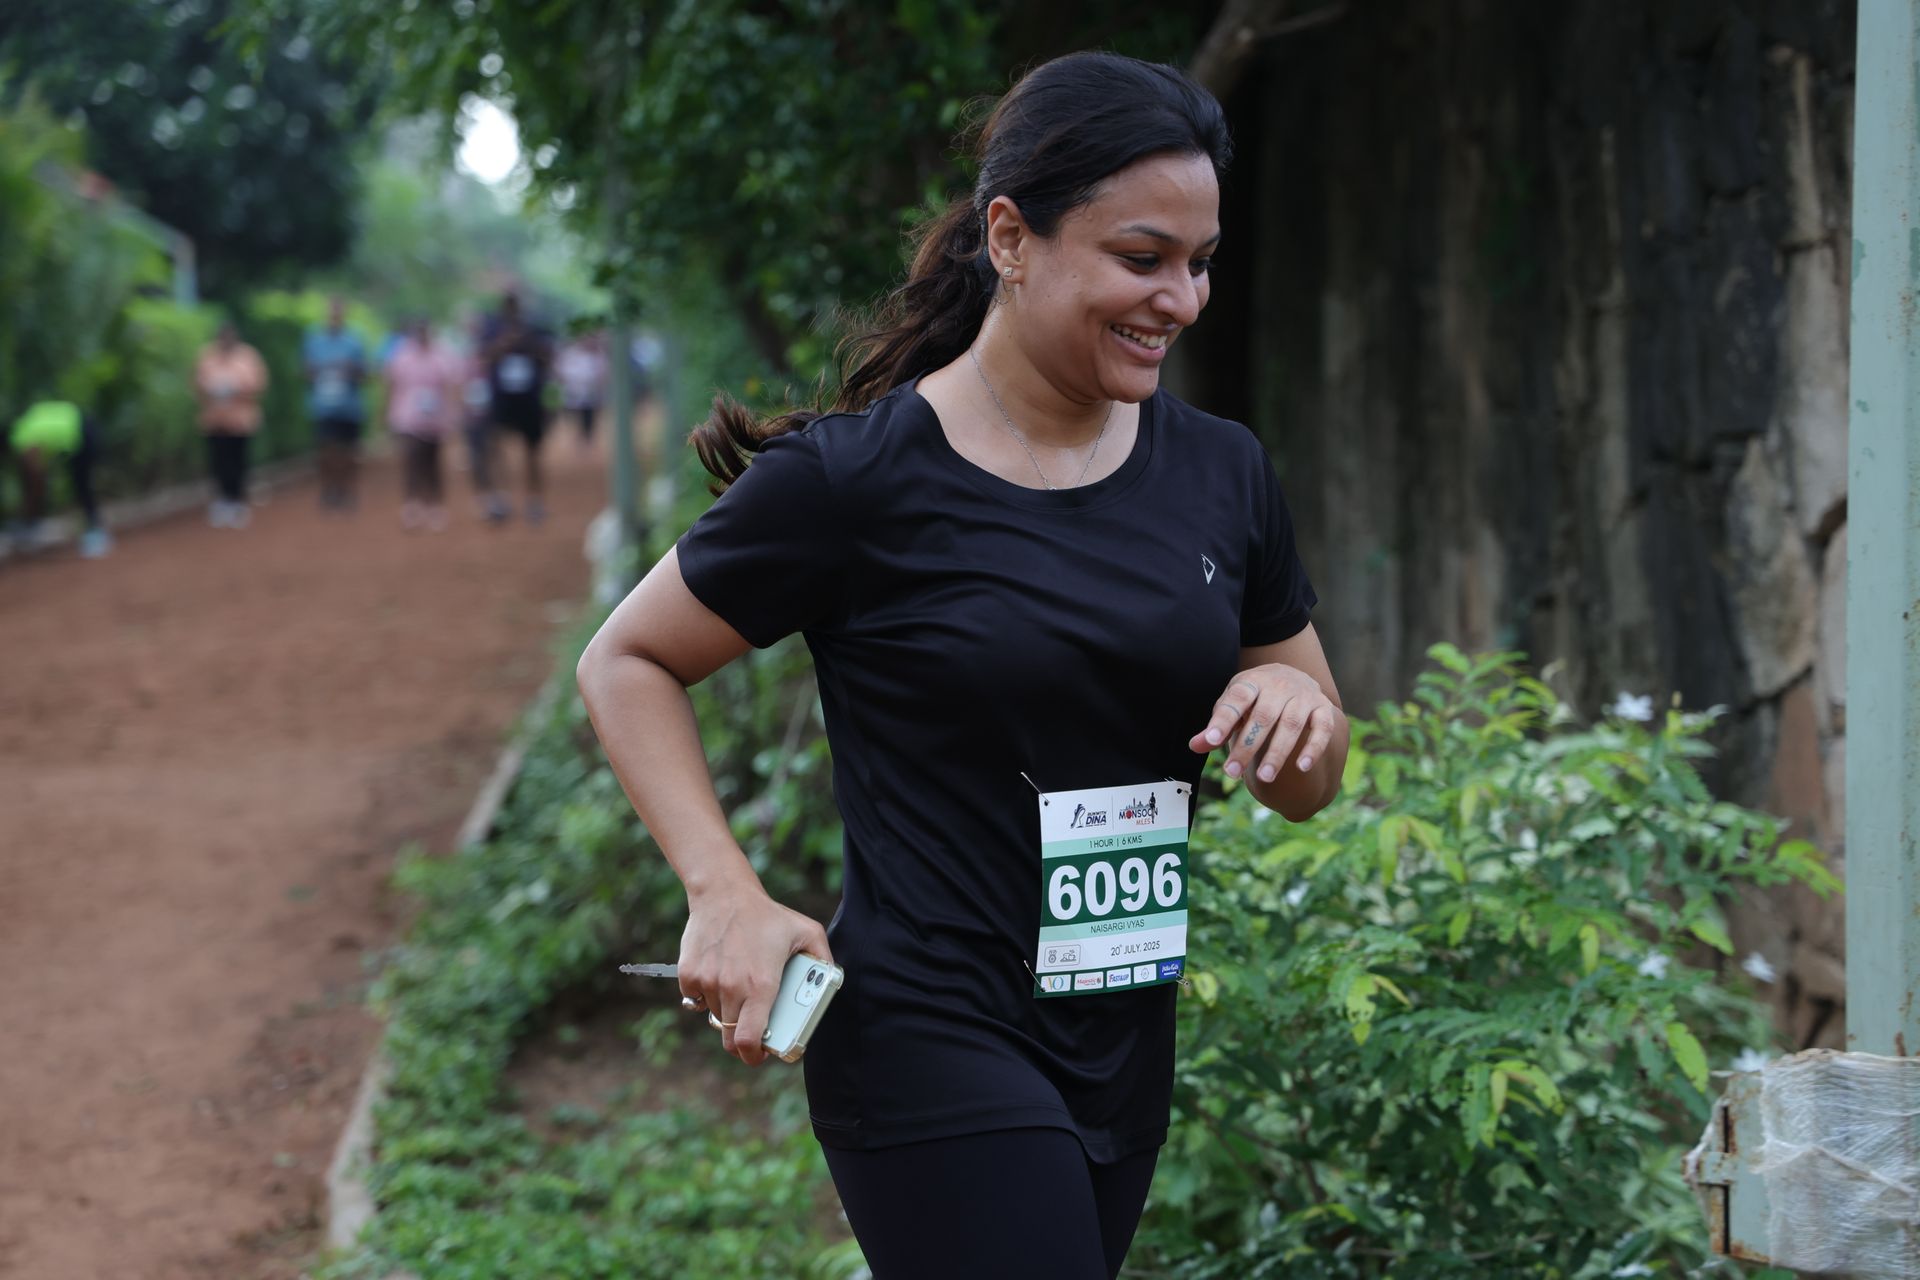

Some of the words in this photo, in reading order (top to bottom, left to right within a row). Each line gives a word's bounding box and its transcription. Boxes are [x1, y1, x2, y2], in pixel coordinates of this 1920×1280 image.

[1085, 814, 1106, 824] DINA
[1118, 807, 1158, 821] MONSOON
[1094, 837, 1114, 848] HOUR
[1122, 837, 1127, 846] 6
[1128, 834, 1143, 844] KMS
[1048, 853, 1182, 920] 6096
[1090, 922, 1126, 934] NAISARGI
[1127, 919, 1145, 928] VYAS
[1143, 940, 1161, 952] 2025
